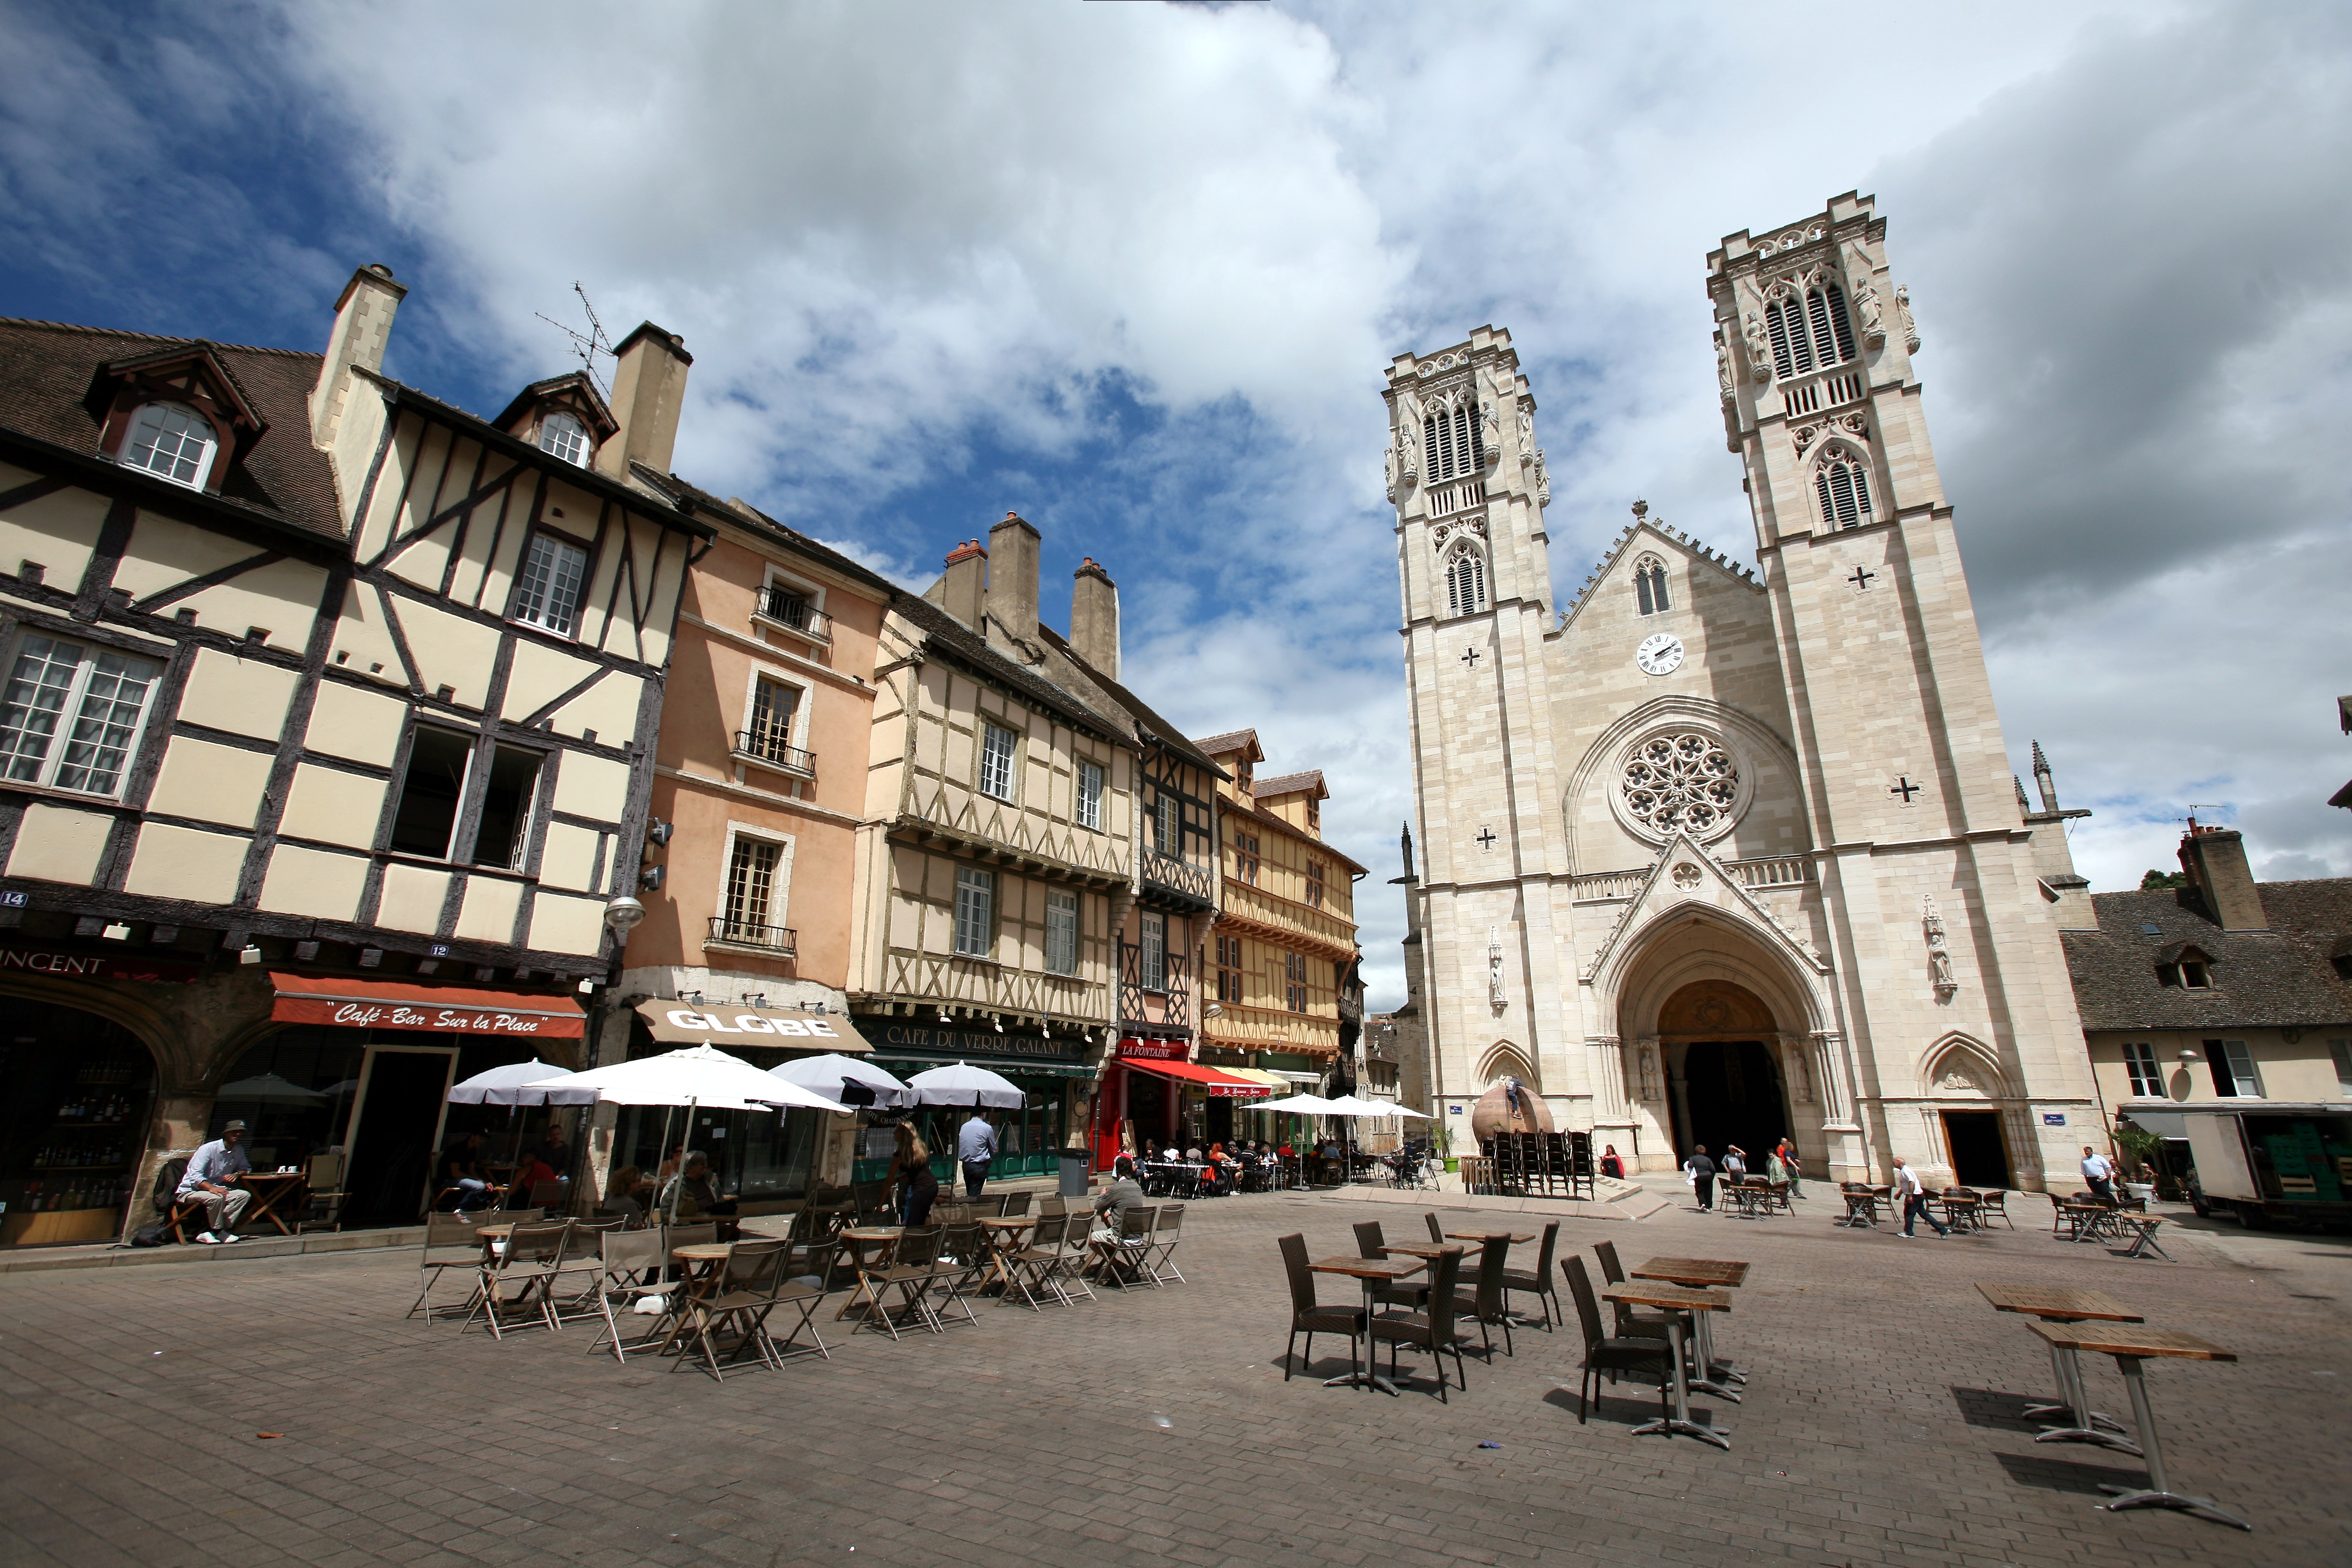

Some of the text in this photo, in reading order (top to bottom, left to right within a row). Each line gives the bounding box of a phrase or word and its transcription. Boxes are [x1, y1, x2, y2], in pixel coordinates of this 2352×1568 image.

[3, 893, 24, 905] 14
[432, 946, 446, 956] 12
[433, 1010, 468, 1027] Sur
[473, 1014, 490, 1030] la
[666, 1010, 840, 1038] GLOBE
[887, 1026, 929, 1046] CAFE
[935, 1031, 957, 1047] DU
[963, 1033, 1011, 1052] VERRE
[1016, 1038, 1062, 1055] GALANT
[1122, 1045, 1170, 1058] LA FONTAINE
[1201, 1054, 1246, 1066] SAINT VINCENT
